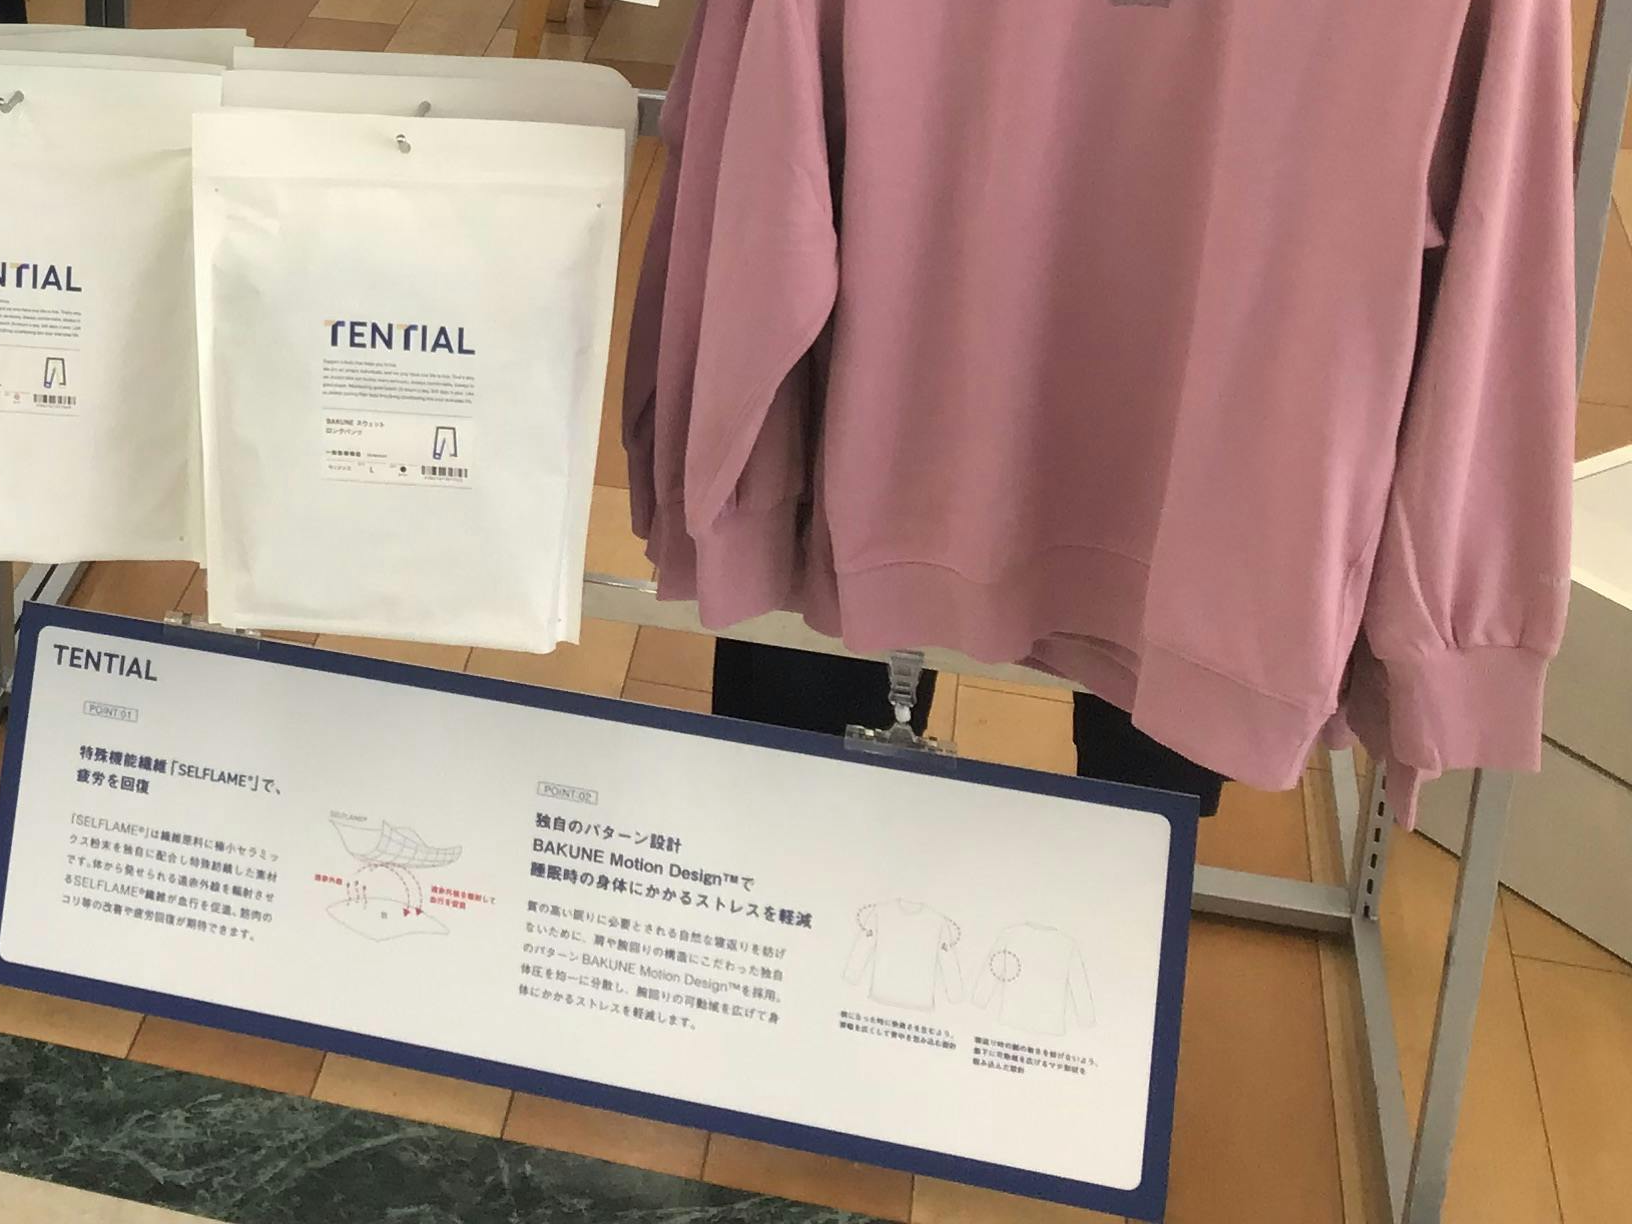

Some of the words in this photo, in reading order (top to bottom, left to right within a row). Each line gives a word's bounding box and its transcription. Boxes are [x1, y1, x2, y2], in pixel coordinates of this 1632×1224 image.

[323, 319, 476, 356] TENTIAL
[53, 643, 158, 682] TENTIAL
[76, 767, 151, 795] 疲労を回復
[535, 811, 682, 855] 独自のパターン設計
[532, 838, 605, 865] BAKUNE
[609, 851, 664, 876] Motion
